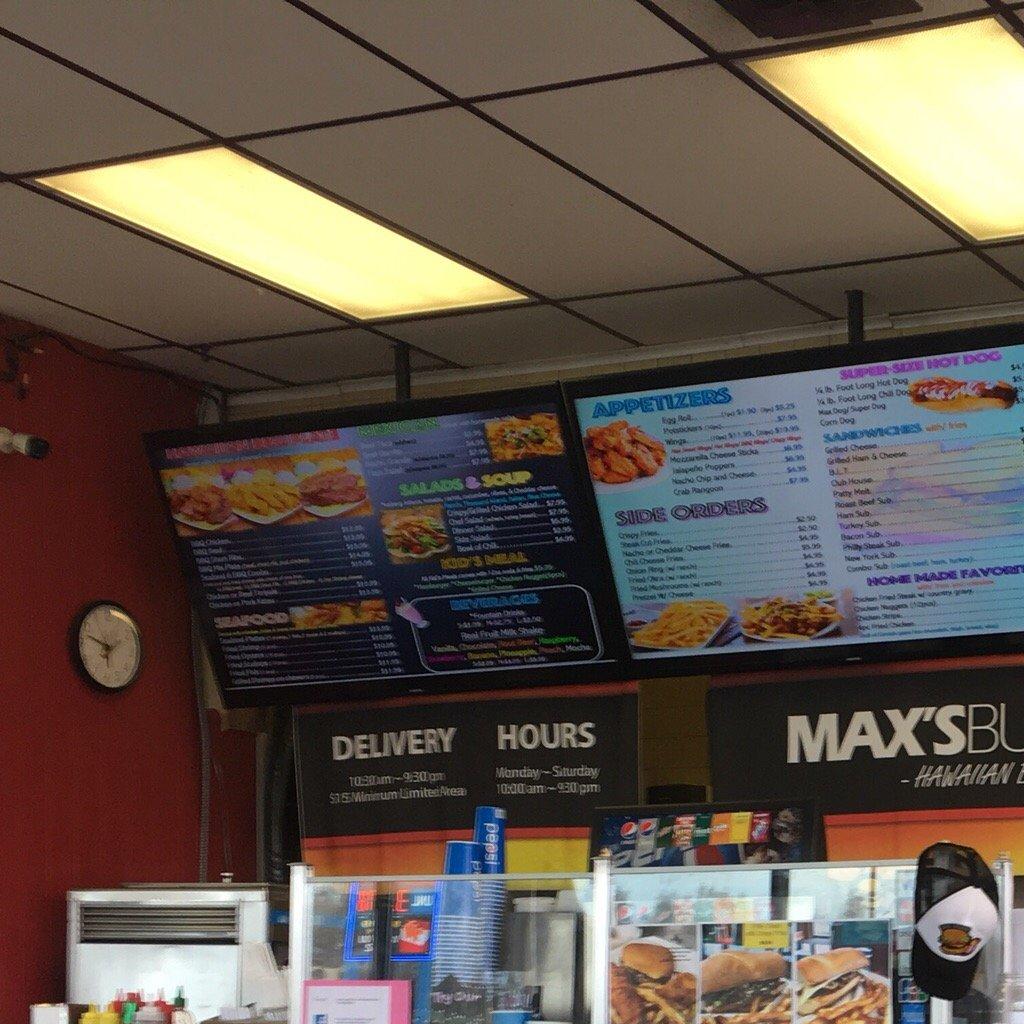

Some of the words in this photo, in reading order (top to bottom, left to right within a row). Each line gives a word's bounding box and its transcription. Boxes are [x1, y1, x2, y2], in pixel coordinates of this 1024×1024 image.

[926, 356, 959, 370] HOT
[963, 350, 1003, 365] DOG
[592, 387, 733, 419] APPETIZERS
[822, 422, 922, 444] SANDWICHES
[398, 477, 465, 498] SALADS
[615, 506, 668, 528] SIDE
[670, 497, 769, 521] ORDERS
[866, 572, 912, 587] HOME
[913, 567, 959, 583] MADE
[331, 726, 458, 762] DELIVERY
[496, 721, 599, 751] HOURS
[495, 766, 542, 781] Monday
[914, 762, 1018, 789] HAWAIIAN
